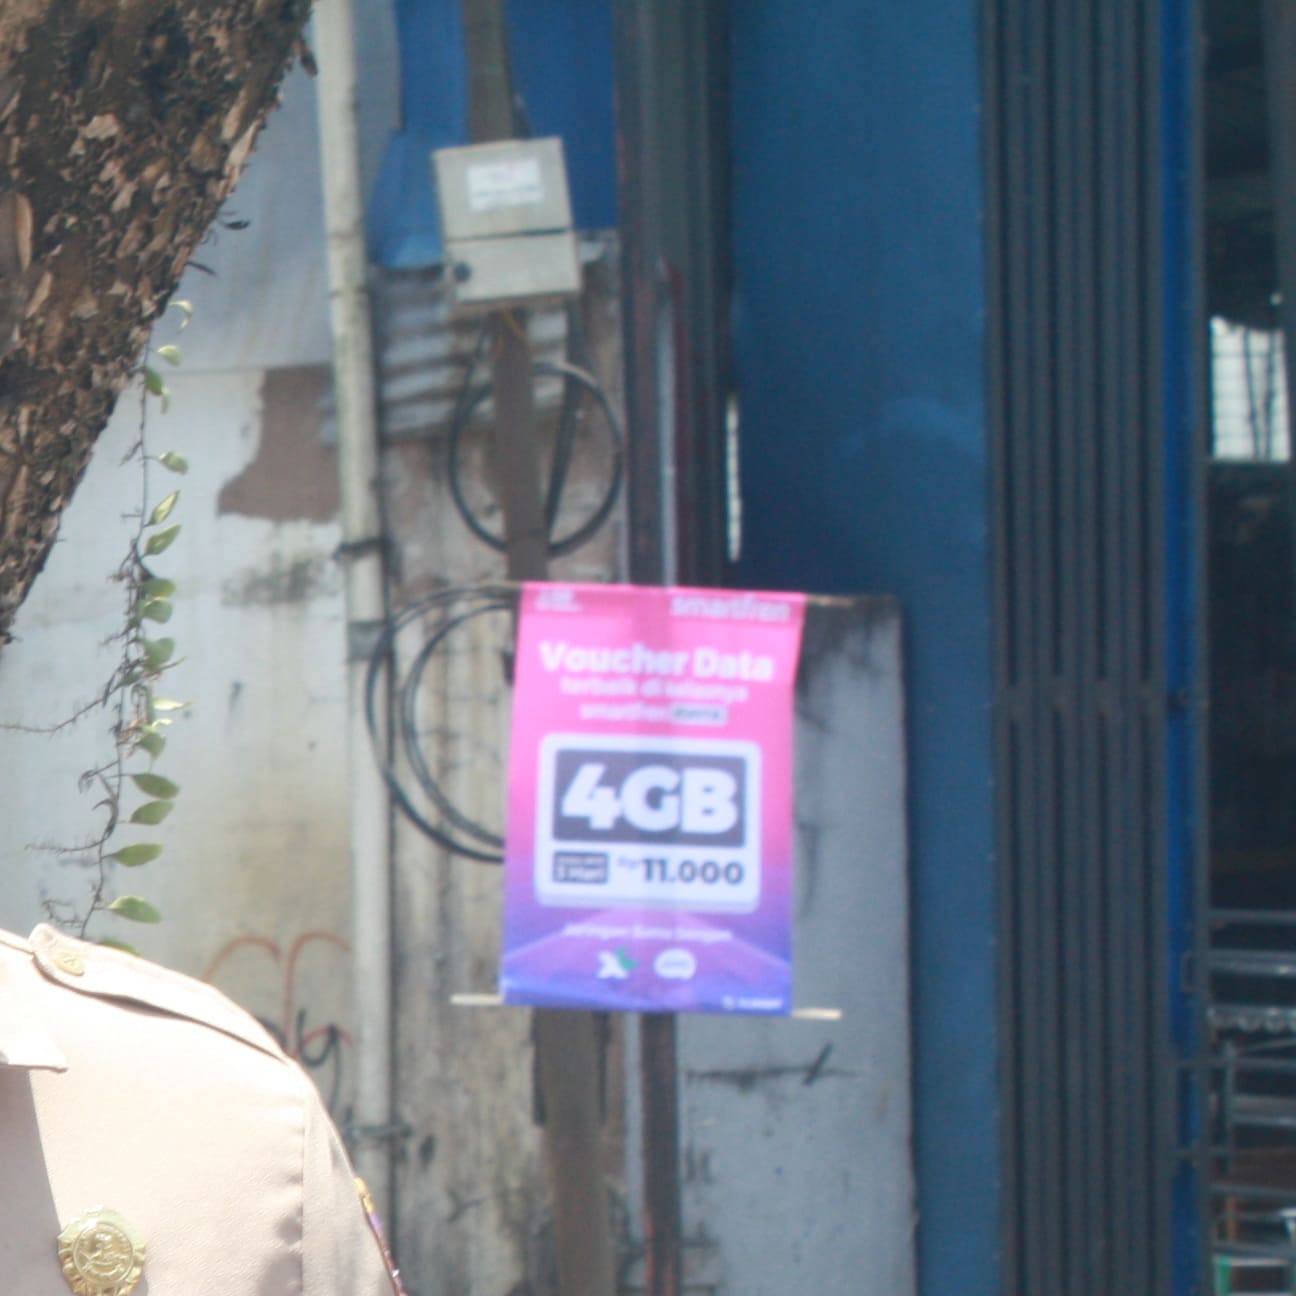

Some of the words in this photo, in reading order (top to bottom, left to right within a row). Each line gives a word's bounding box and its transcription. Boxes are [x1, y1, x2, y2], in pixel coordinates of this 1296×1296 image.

[537, 640, 689, 678] Voucher
[693, 648, 774, 683] Data
[560, 762, 740, 836] 4GB
[640, 857, 745, 885] 11.000
